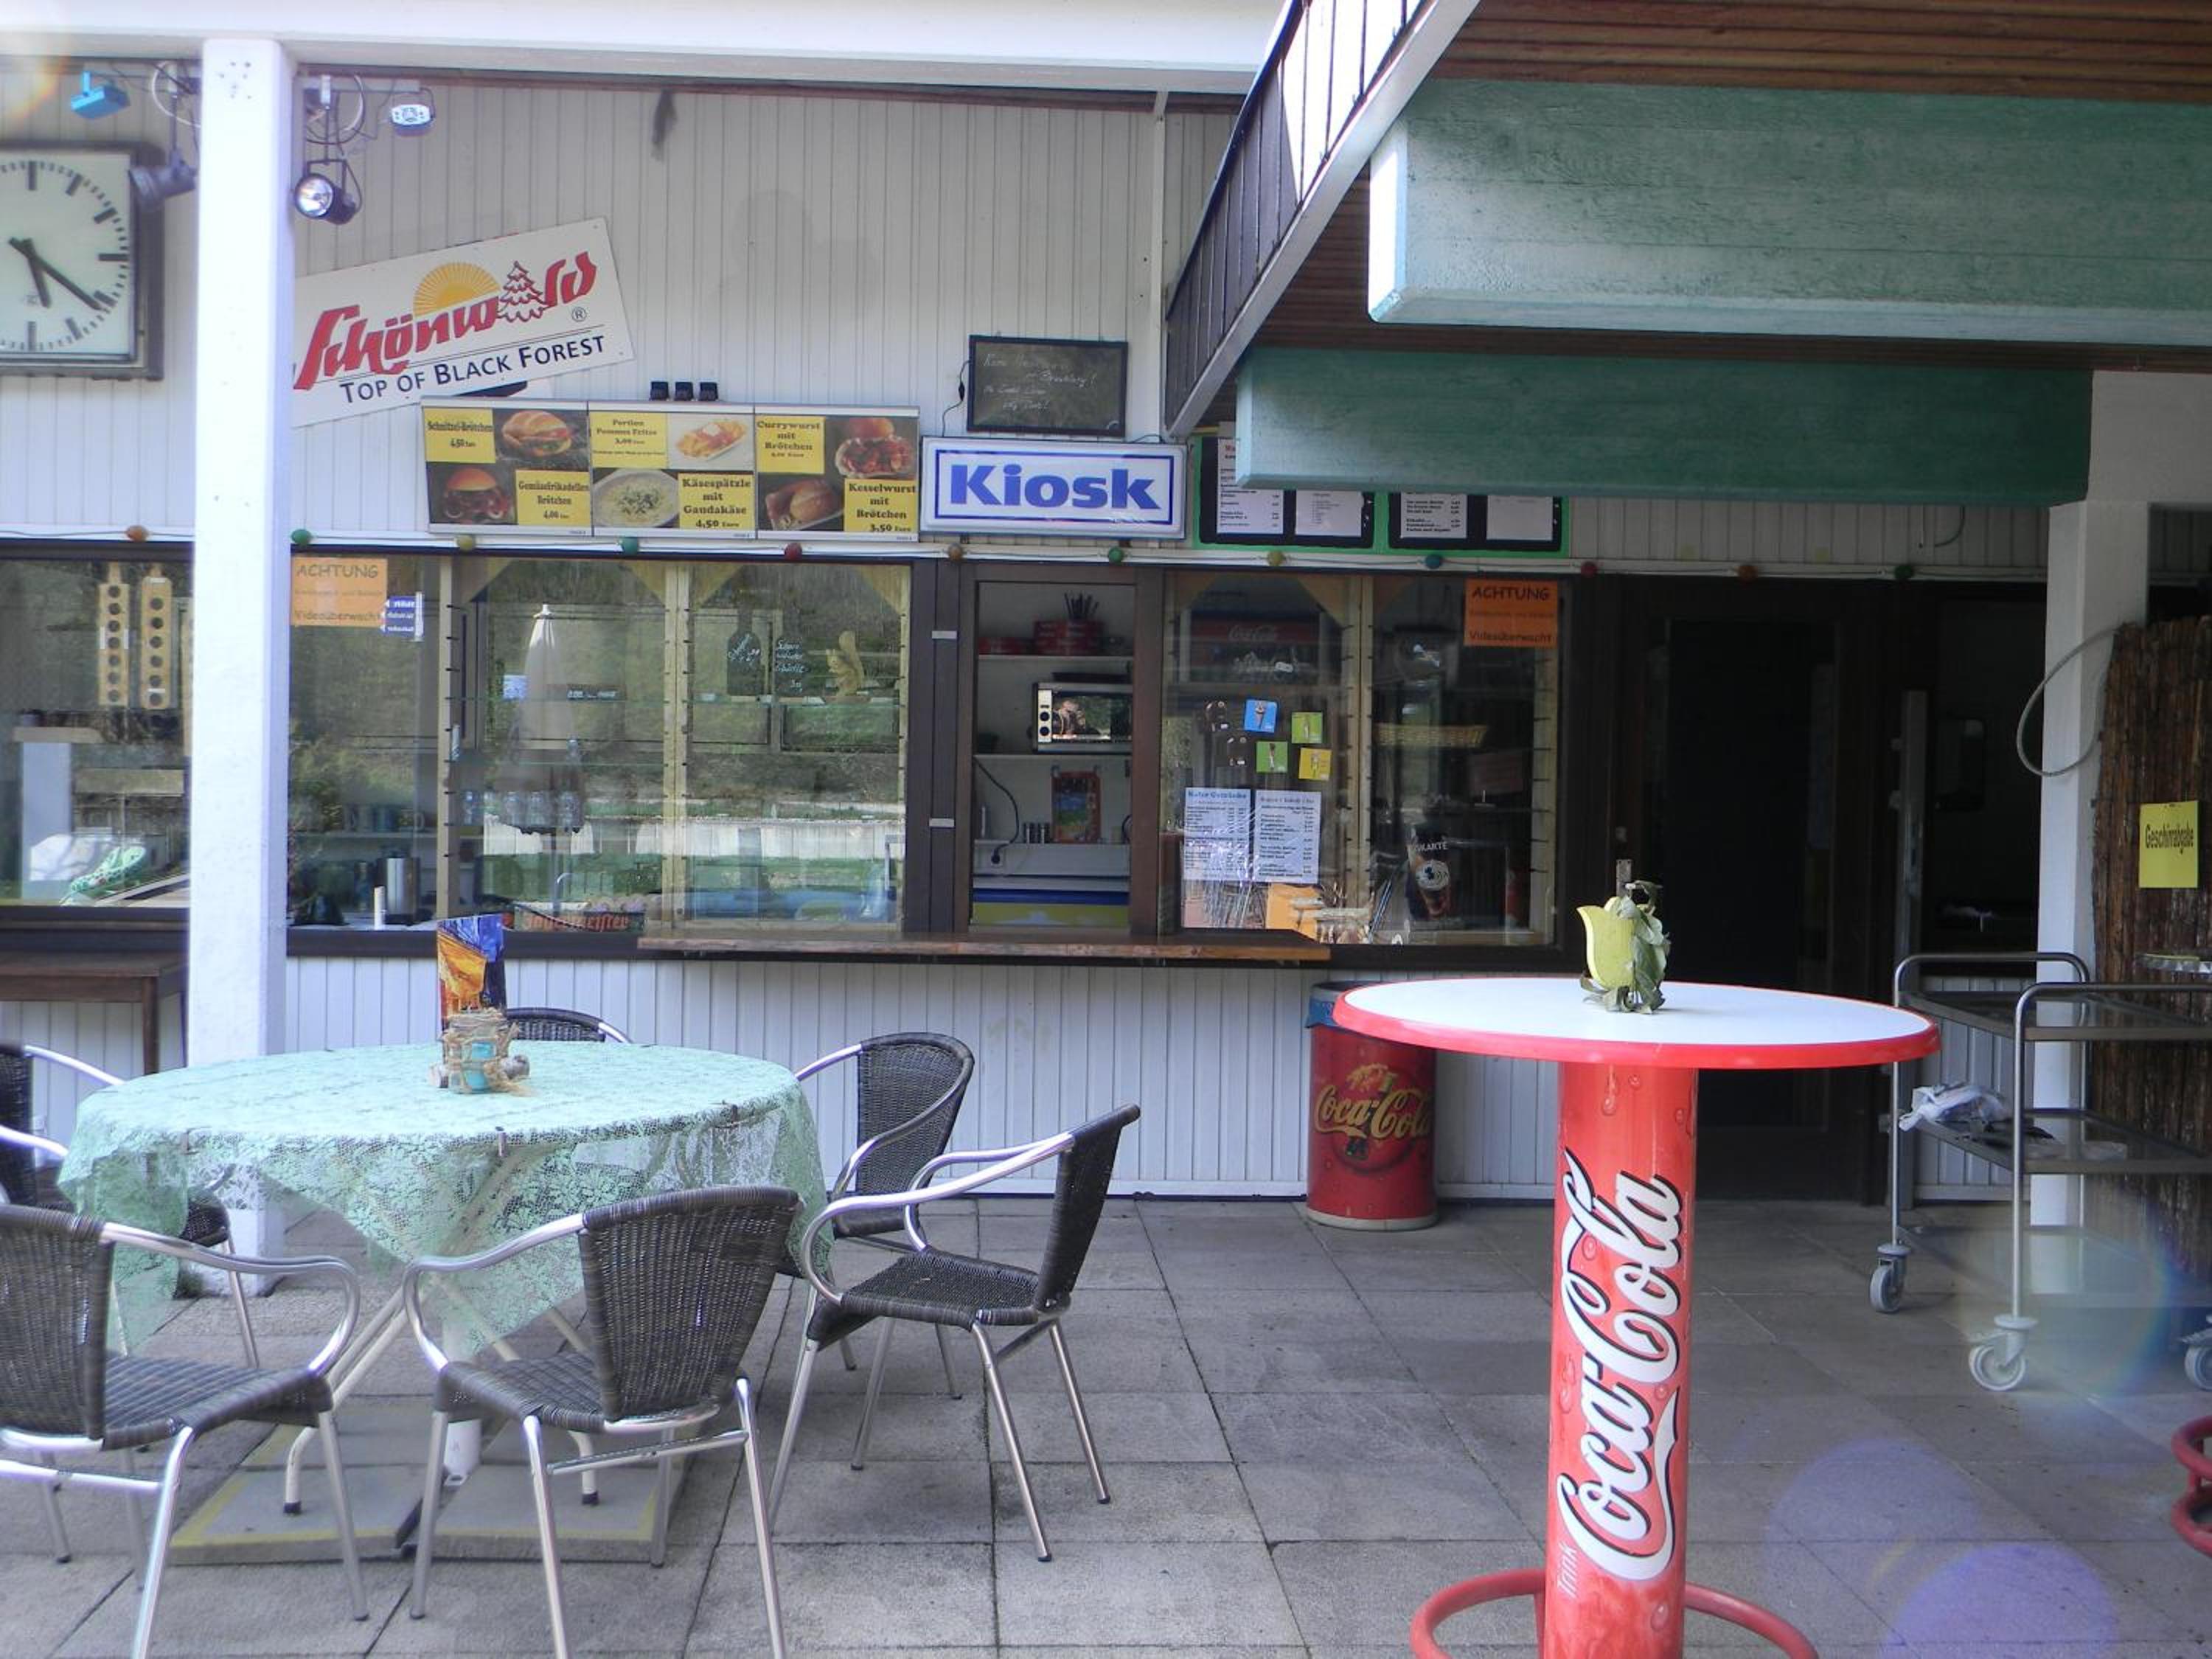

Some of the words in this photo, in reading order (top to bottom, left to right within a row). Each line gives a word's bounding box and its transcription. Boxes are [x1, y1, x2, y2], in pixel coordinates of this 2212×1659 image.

[340, 379, 388, 403] TOP
[397, 372, 426, 393] OF
[434, 352, 512, 386] BLACK
[519, 335, 605, 369] FOREST
[757, 421, 820, 429] Currywurst
[682, 479, 751, 489] Käsespätzle
[849, 483, 916, 493] Kesselwurst
[950, 463, 1161, 509] Kiosk
[703, 492, 723, 501] mit
[870, 496, 888, 505] mit
[856, 509, 907, 519] Brötchen
[296, 564, 379, 578] ACHTUNG
[1472, 586, 1550, 601] ACHTUNG
[1557, 1146, 1683, 1581] Coca-Cola
